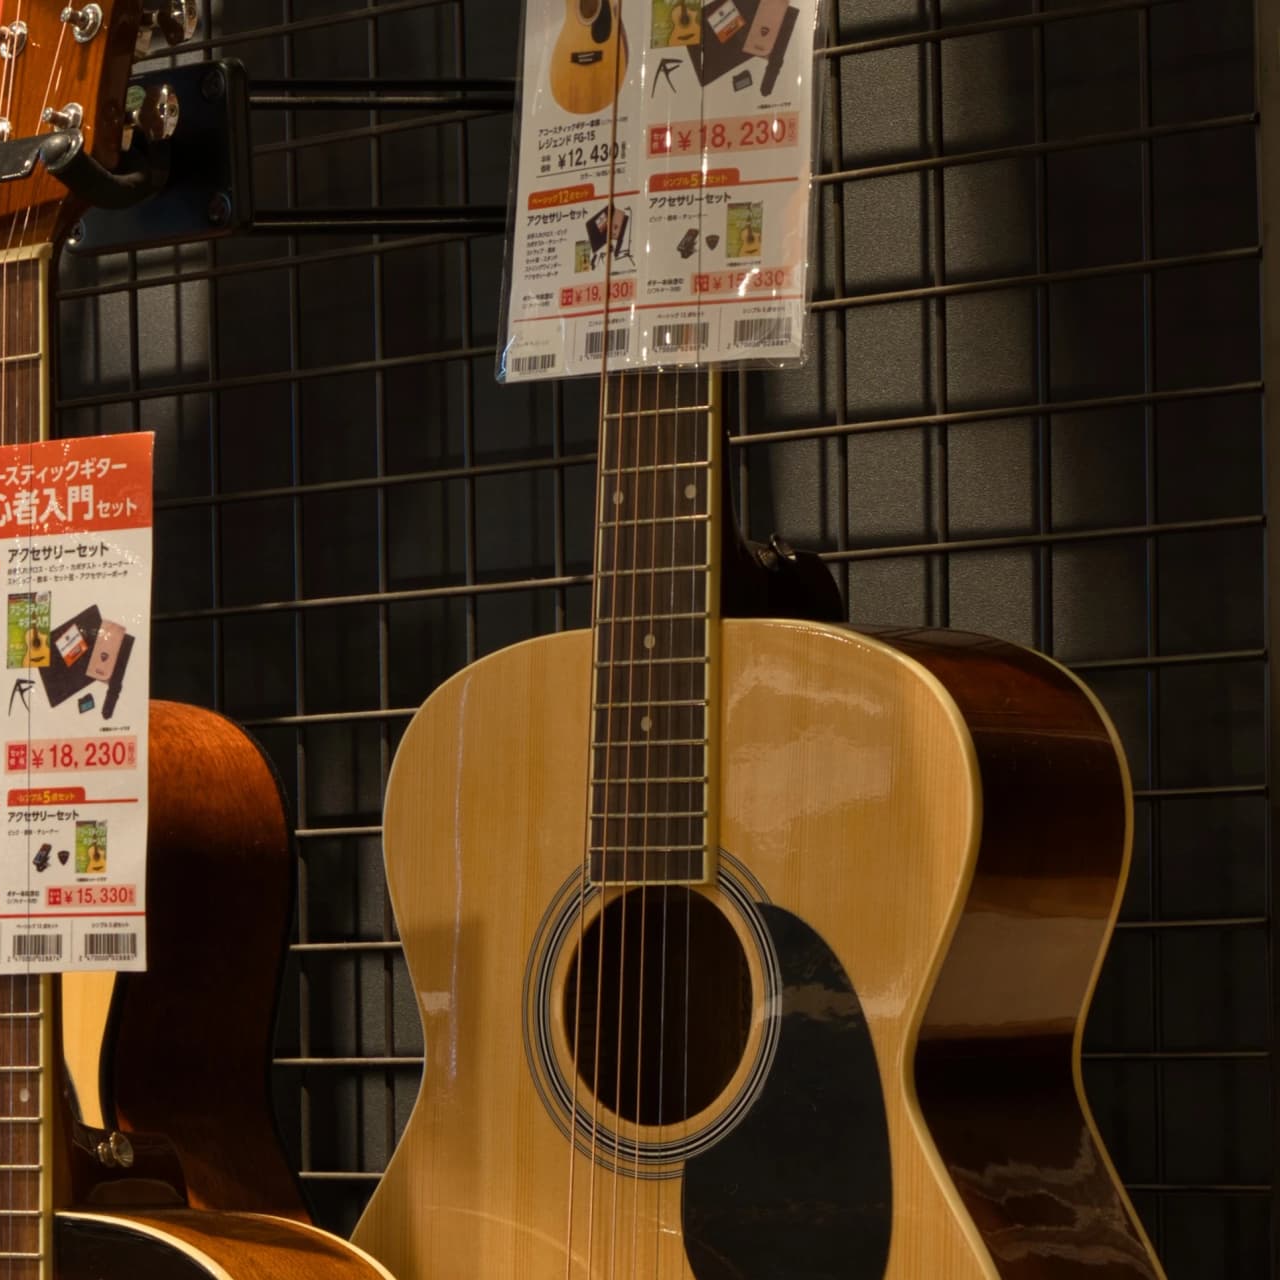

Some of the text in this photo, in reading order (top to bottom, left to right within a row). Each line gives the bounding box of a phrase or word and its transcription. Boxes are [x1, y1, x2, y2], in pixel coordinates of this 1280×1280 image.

[678, 119, 786, 151] ¥18,230
[649, 192, 731, 208] アクセサリーセット
[527, 207, 587, 227] アクセサリーセット
[713, 270, 784, 290] ¥15330
[575, 282, 629, 301] ¥19,30
[7, 541, 109, 564] アクセサリーセット
[31, 741, 127, 769] ¥18,230
[7, 809, 80, 823] アクセサリーセット
[64, 886, 128, 905] ¥15,330
